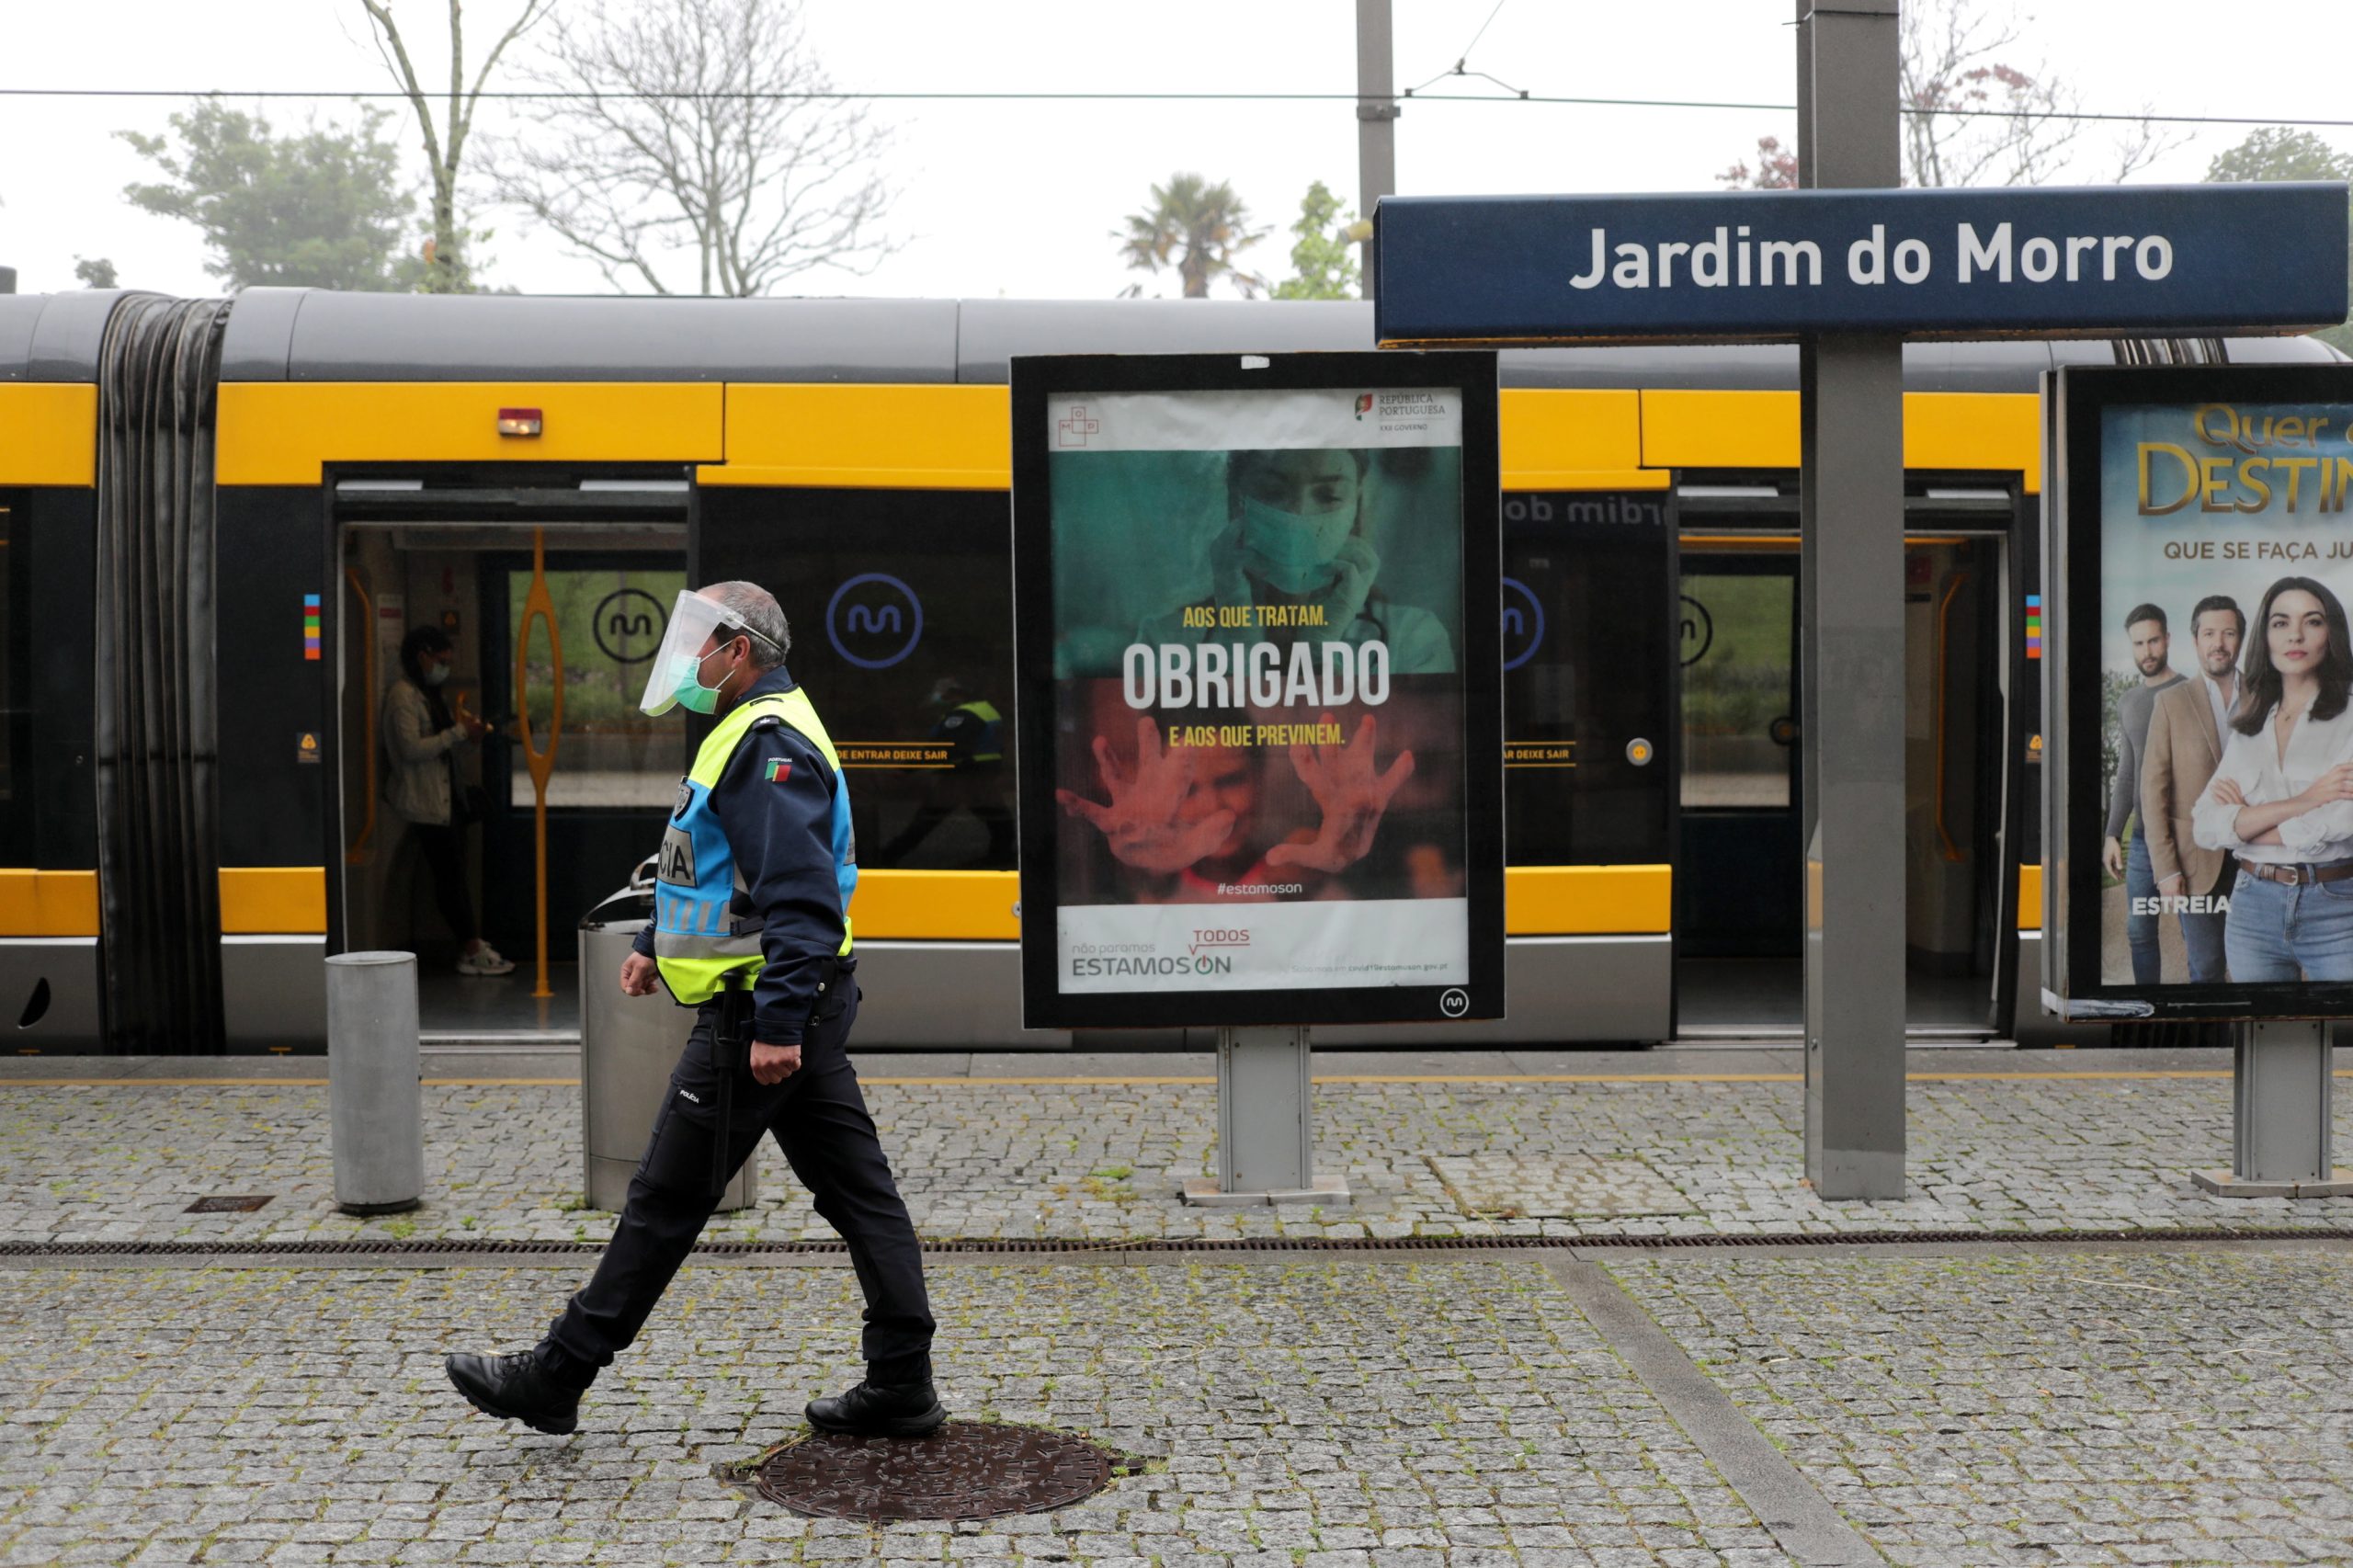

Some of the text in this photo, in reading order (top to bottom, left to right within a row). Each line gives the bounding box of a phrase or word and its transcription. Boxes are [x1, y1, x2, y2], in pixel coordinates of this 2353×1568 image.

[1569, 222, 2173, 290] Jardim do Morro
[1380, 393, 1433, 404] REPÚBLICA
[1380, 405, 1446, 415] PORTUGUESA
[1394, 424, 1427, 432] GOVERNO
[2194, 403, 2328, 454] Quer
[2164, 541, 2215, 559] QUE
[2222, 541, 2251, 559] SE
[2257, 541, 2318, 562] FAÇA
[1183, 605, 1328, 628] AOS QUE TRATAM.
[1123, 640, 1390, 709] OBRIGADO
[1169, 723, 1346, 746] E AOS QUE PREVINEM.
[851, 750, 891, 759] ENTRAR
[892, 750, 922, 759] DEIXE
[925, 750, 948, 759] SAIR
[1516, 750, 1544, 758] DEIXE
[1546, 750, 1569, 758] SAIR
[1218, 883, 1302, 895] #estamoson
[2132, 895, 2232, 915] ESTREIA
[1193, 929, 1250, 942] TODOS
[1073, 943, 1155, 956] não paramos
